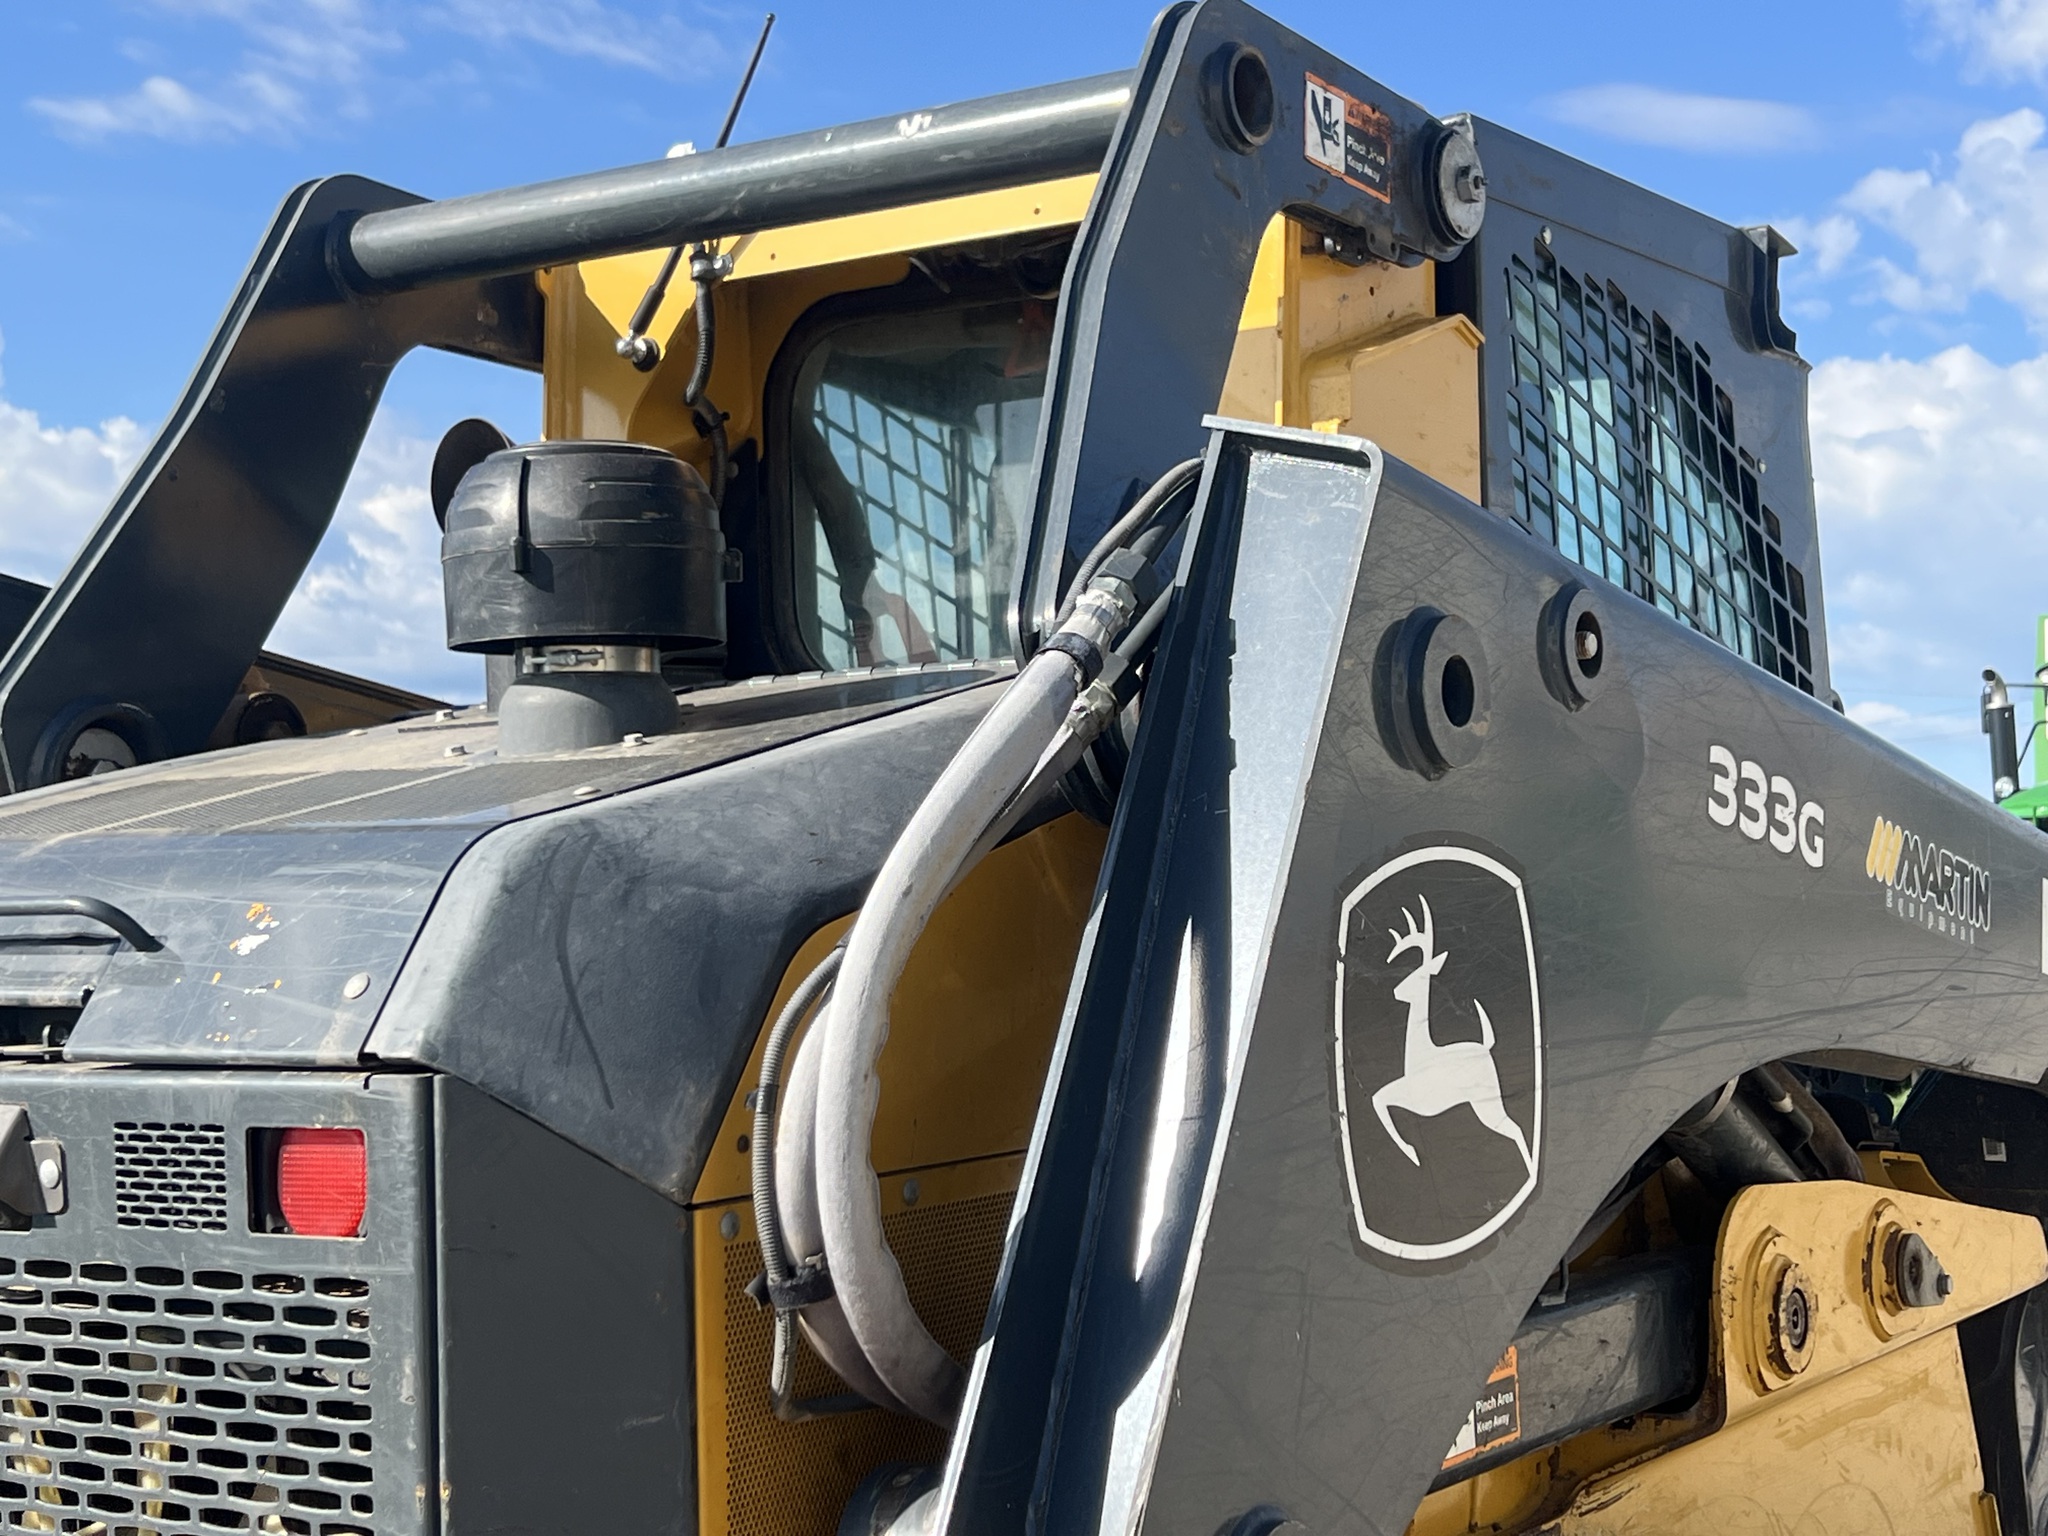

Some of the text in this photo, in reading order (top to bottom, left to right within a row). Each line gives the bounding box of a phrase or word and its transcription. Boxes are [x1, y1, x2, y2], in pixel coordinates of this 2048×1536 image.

[1708, 745, 1824, 868] 333G
[1894, 830, 1991, 932] MARTIN
[1475, 1391, 1514, 1415] Pinch Area
[1476, 1413, 1510, 1434] Keep Away
